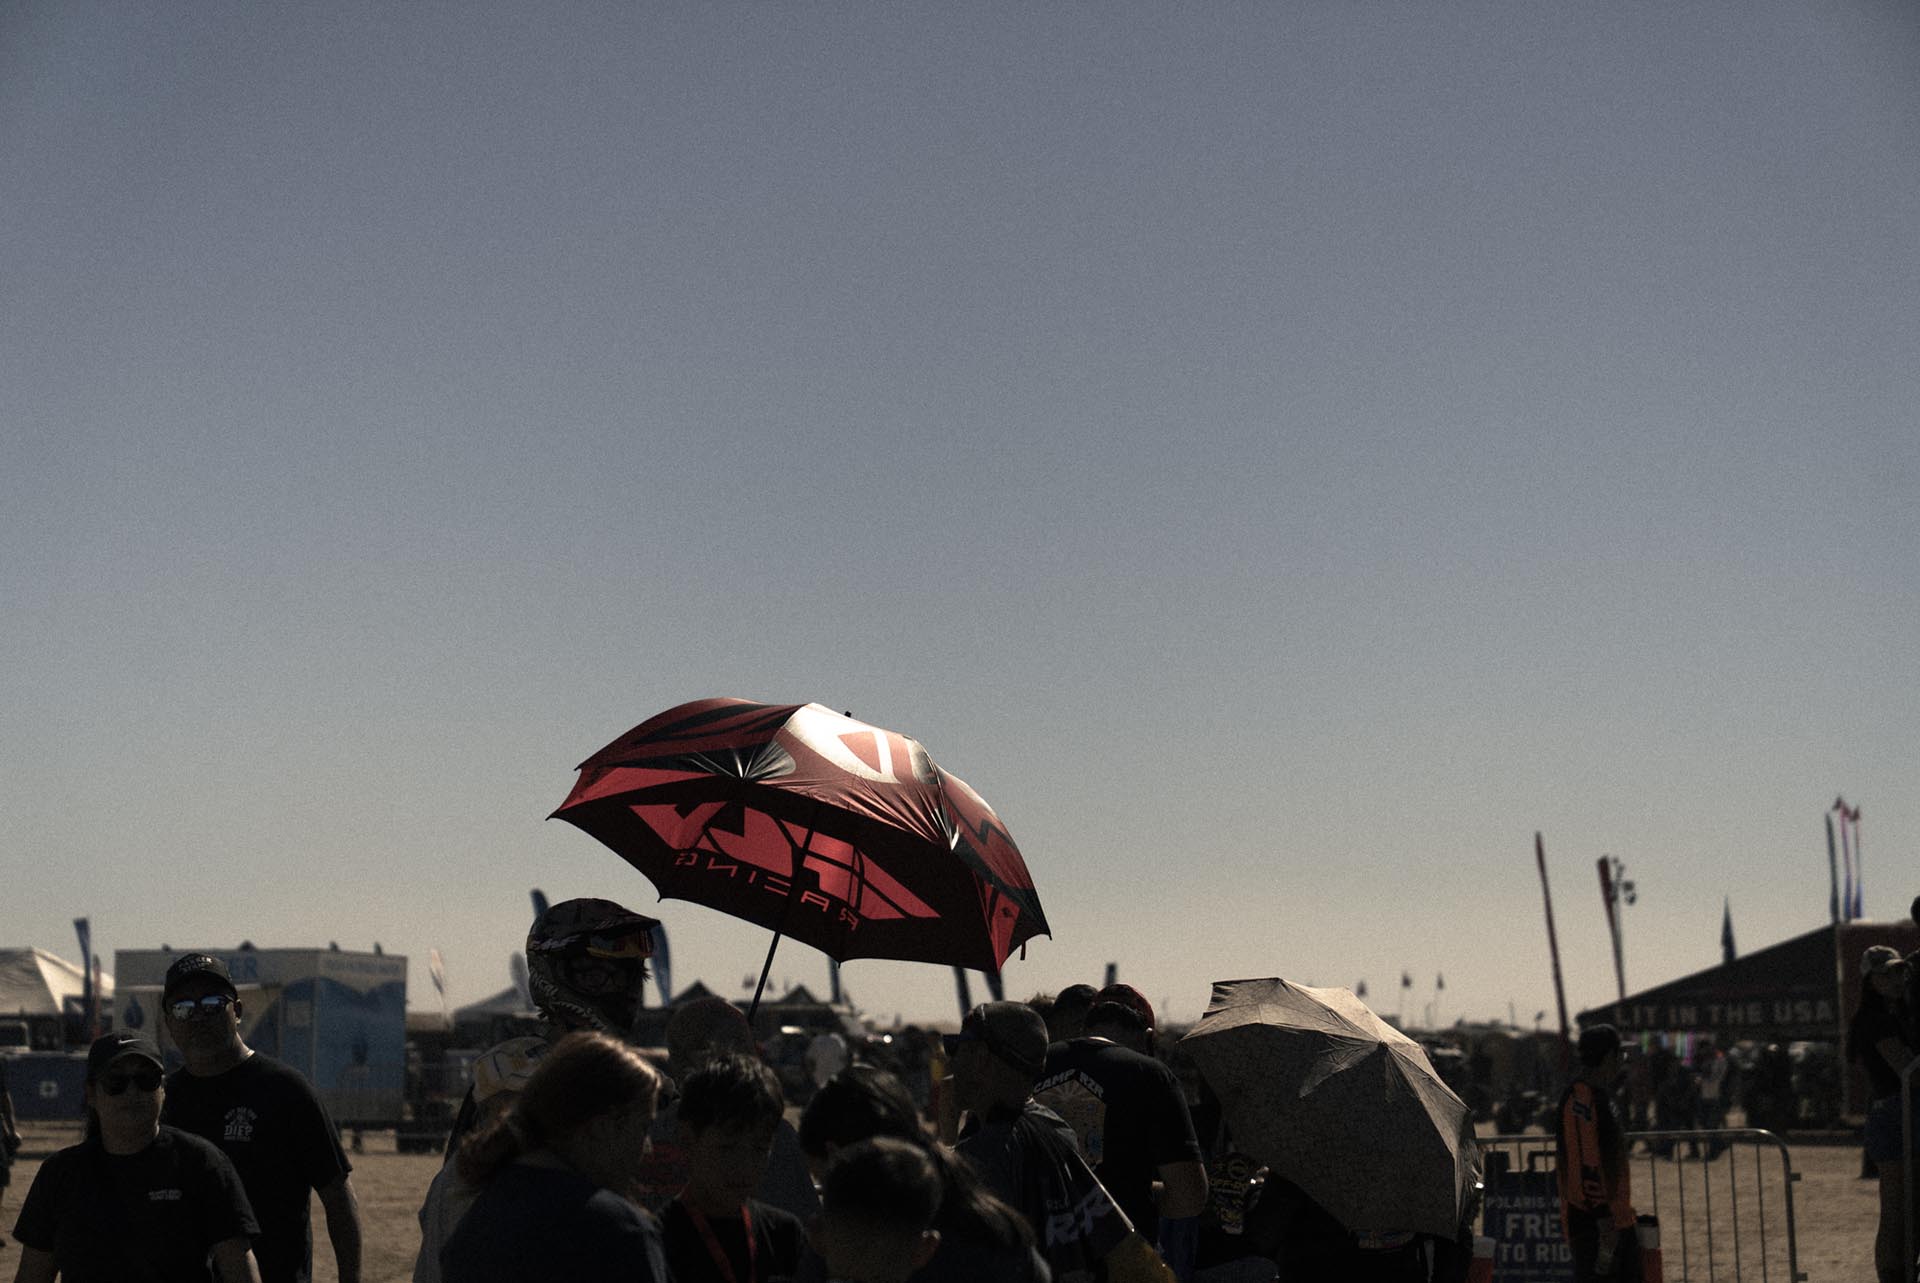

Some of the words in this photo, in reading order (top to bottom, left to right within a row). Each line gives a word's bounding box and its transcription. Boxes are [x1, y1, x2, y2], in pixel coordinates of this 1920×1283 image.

[1667, 1004, 1697, 1025] IN
[1706, 1002, 1763, 1025] THE
[1774, 1000, 1834, 1024] USA
[1033, 1068, 1076, 1094] CAMP
[1486, 1195, 1546, 1210] POLARIS
[1505, 1213, 1561, 1239] FRE
[1499, 1243, 1526, 1263] TO
[1536, 1243, 1573, 1263] RID
